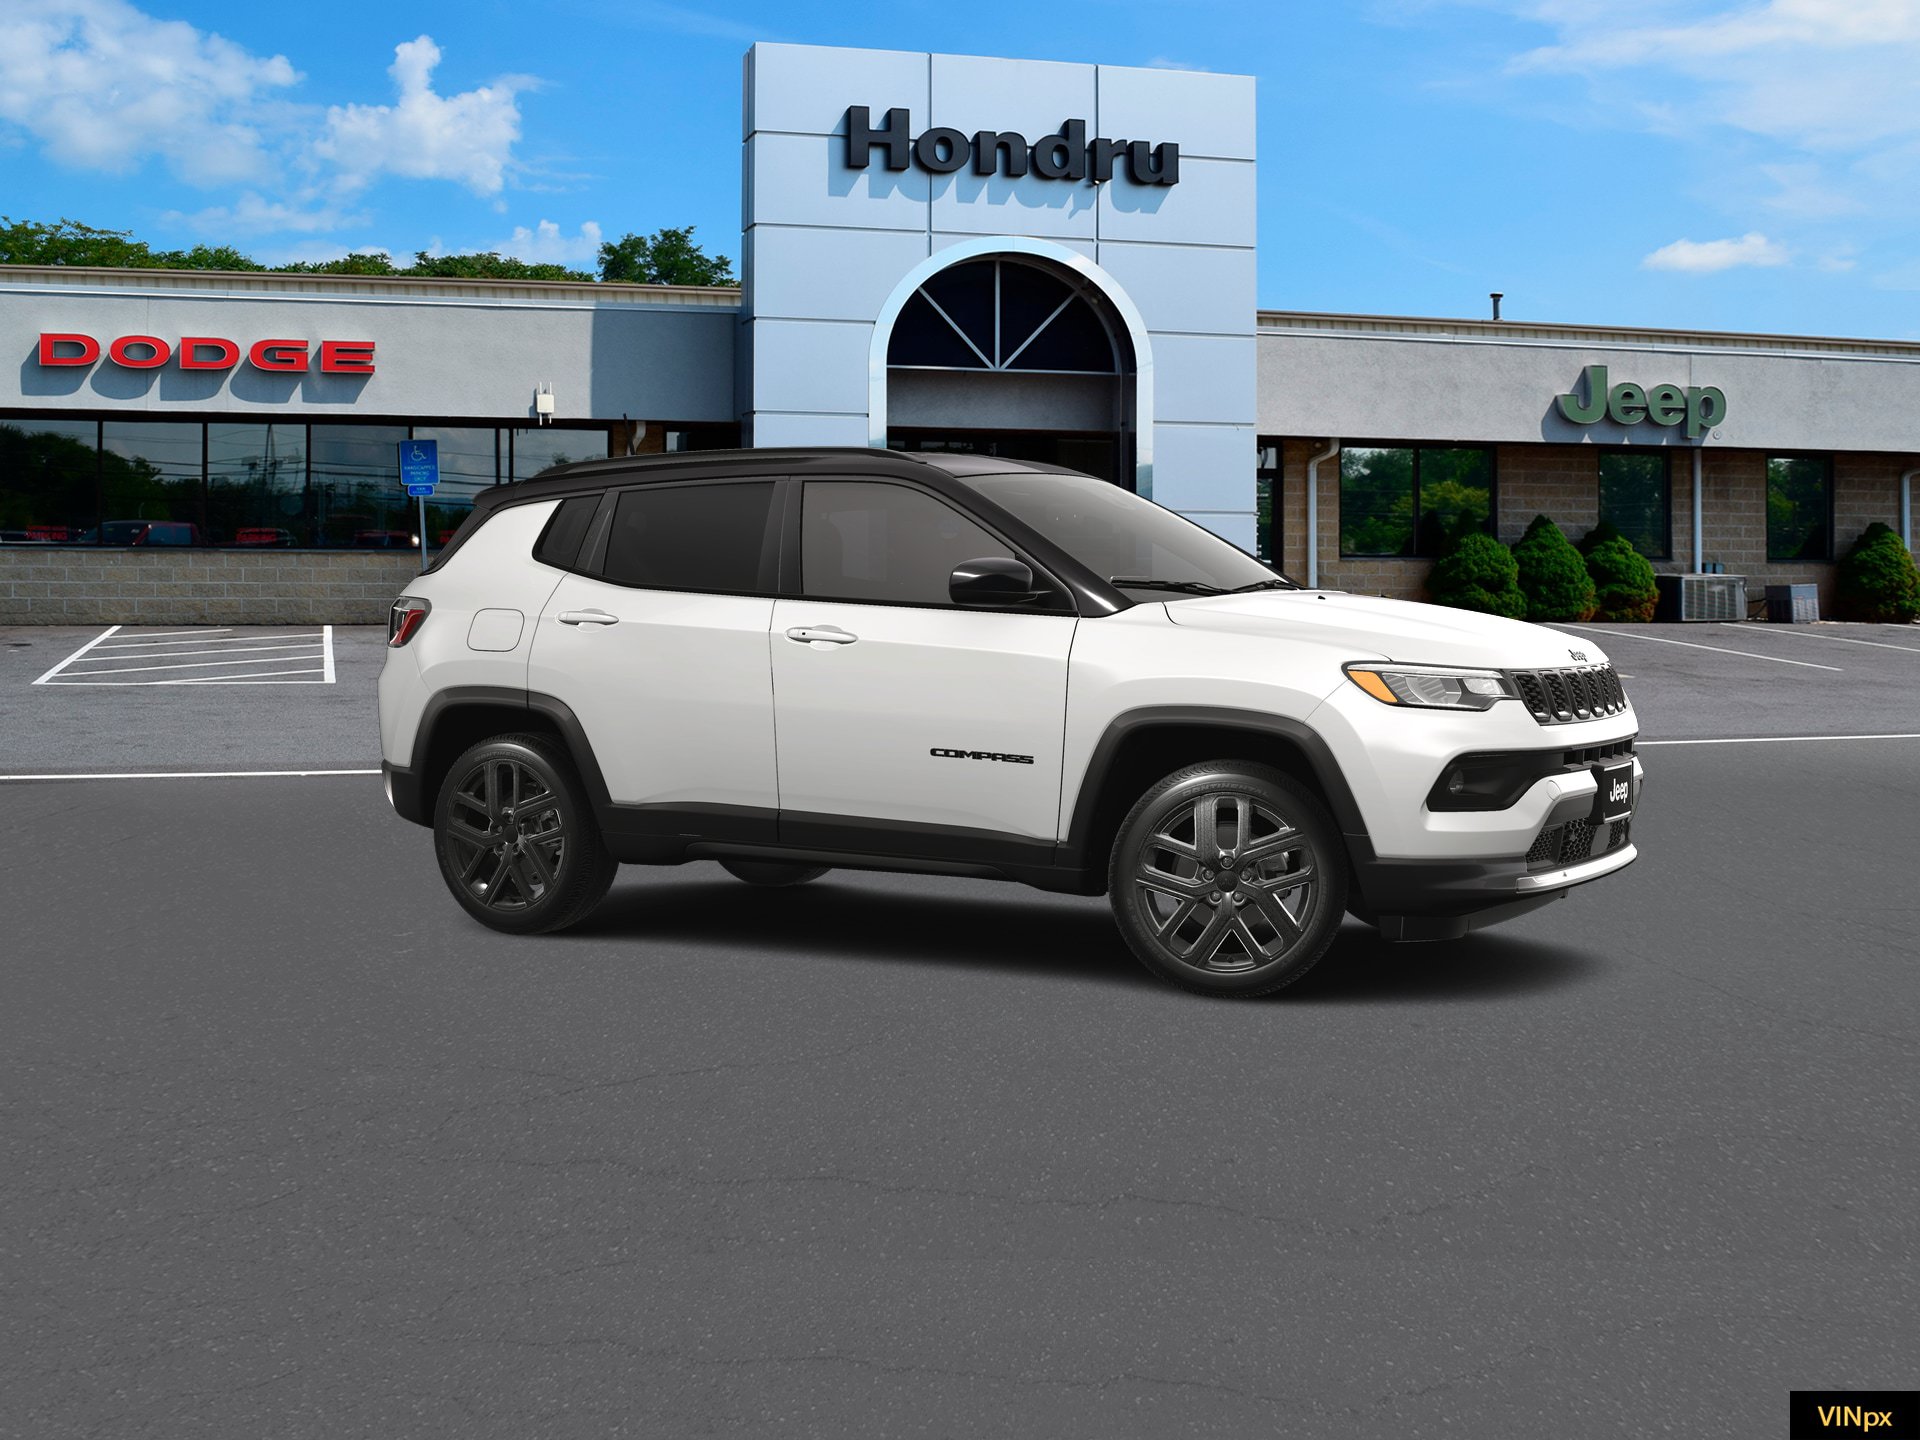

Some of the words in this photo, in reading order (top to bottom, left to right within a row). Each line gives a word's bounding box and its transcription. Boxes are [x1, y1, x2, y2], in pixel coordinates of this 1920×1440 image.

[846, 105, 1180, 185] Hondru
[38, 332, 376, 375] DODGE
[1556, 364, 1727, 440] Jeep
[930, 748, 1034, 764] COMPASS
[1609, 778, 1629, 804] Jeep
